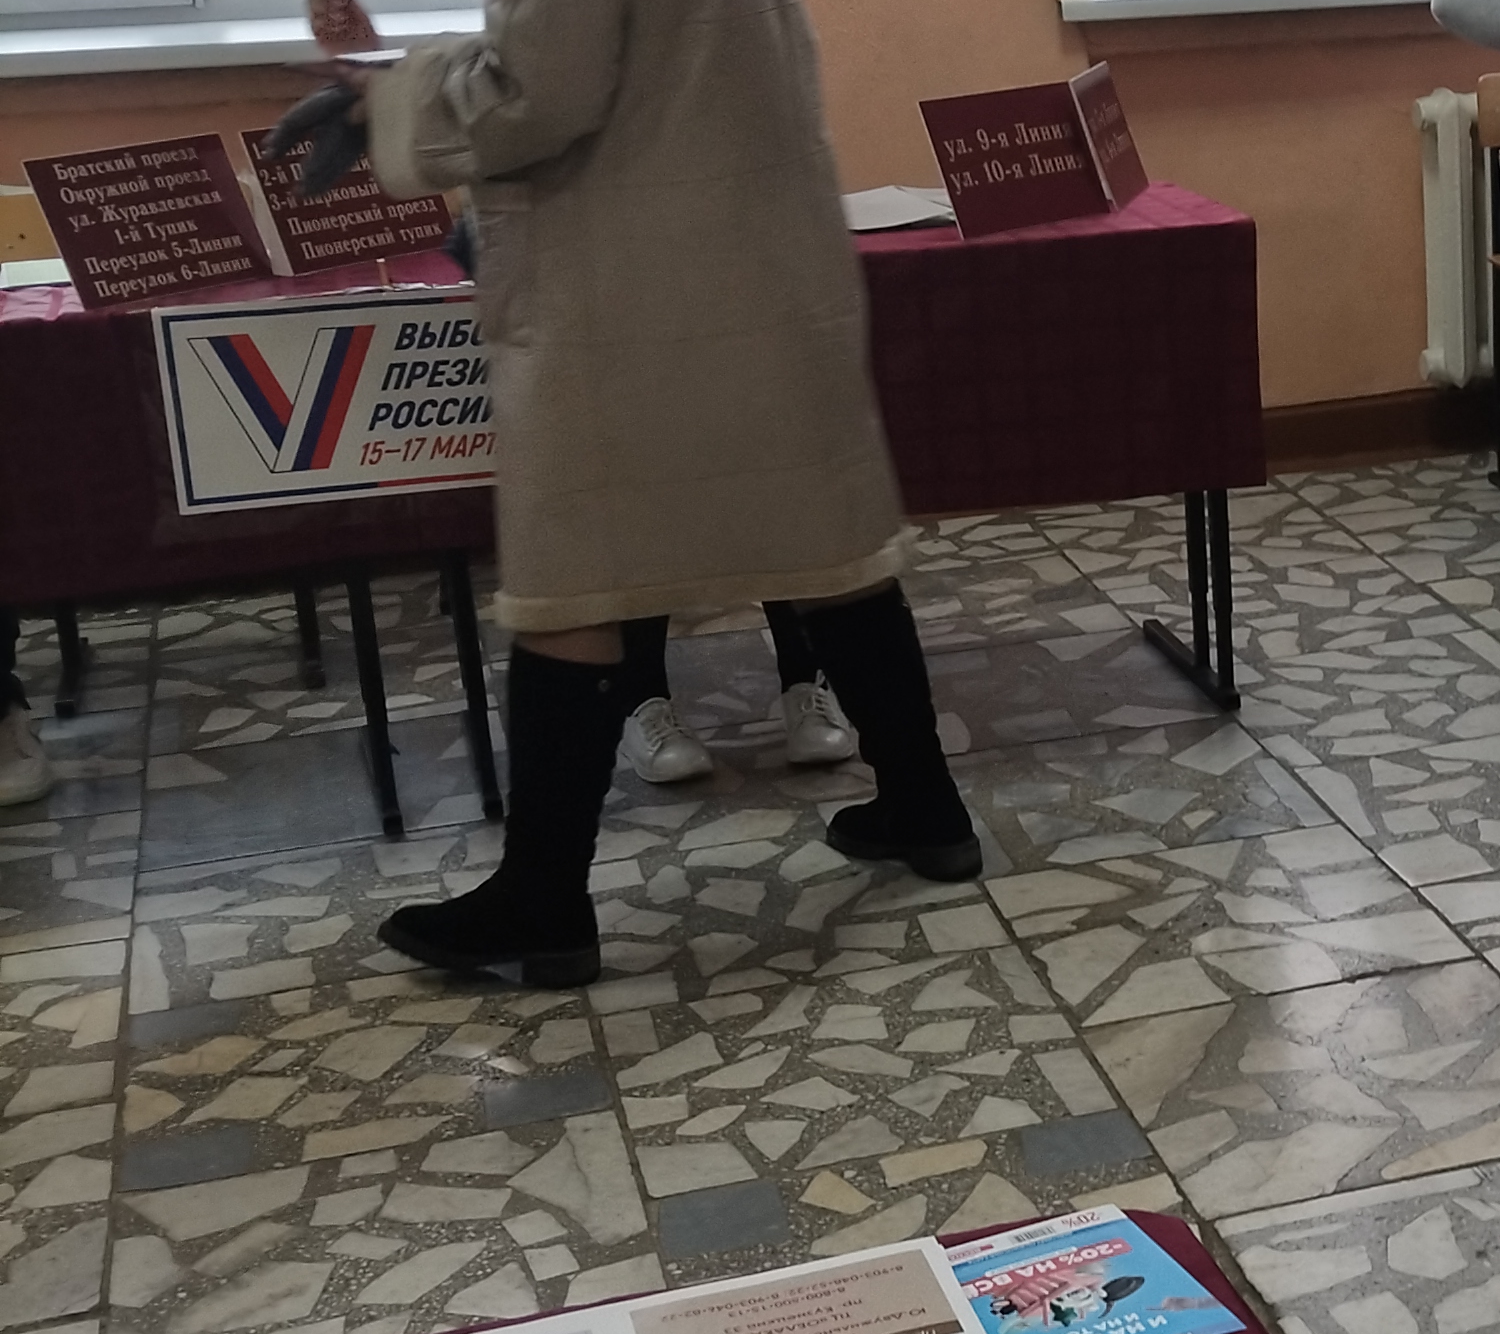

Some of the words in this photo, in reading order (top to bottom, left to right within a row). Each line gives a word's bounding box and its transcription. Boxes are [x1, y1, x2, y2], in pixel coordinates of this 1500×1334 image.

[944, 138, 972, 161] ул.
[976, 127, 1009, 151] 9-я
[53, 153, 136, 183] Братский
[141, 147, 199, 169] проезд
[950, 171, 979, 195] ул.
[982, 161, 1024, 184] 10-я
[60, 175, 150, 204] Окружной
[155, 169, 212, 191] проезд
[68, 215, 96, 232] ул.
[98, 191, 222, 225] Журавлевская
[287, 204, 383, 236] Пионерский
[387, 199, 439, 221] проезд
[114, 226, 142, 245] 1-й
[143, 220, 198, 242] Тупик
[300, 227, 396, 260] Пионерский
[401, 222, 443, 244] тупик
[84, 249, 169, 275] Переулок
[171, 235, 242, 259] 5-Линии
[94, 272, 178, 298] Переулок
[180, 258, 252, 280] 6-Линии
[394, 320, 484, 350] ВЫБО
[381, 357, 490, 391] ПРЕЗИ
[430, 432, 497, 460] МАРТ
[1016, 1258, 1053, 1277] НА
